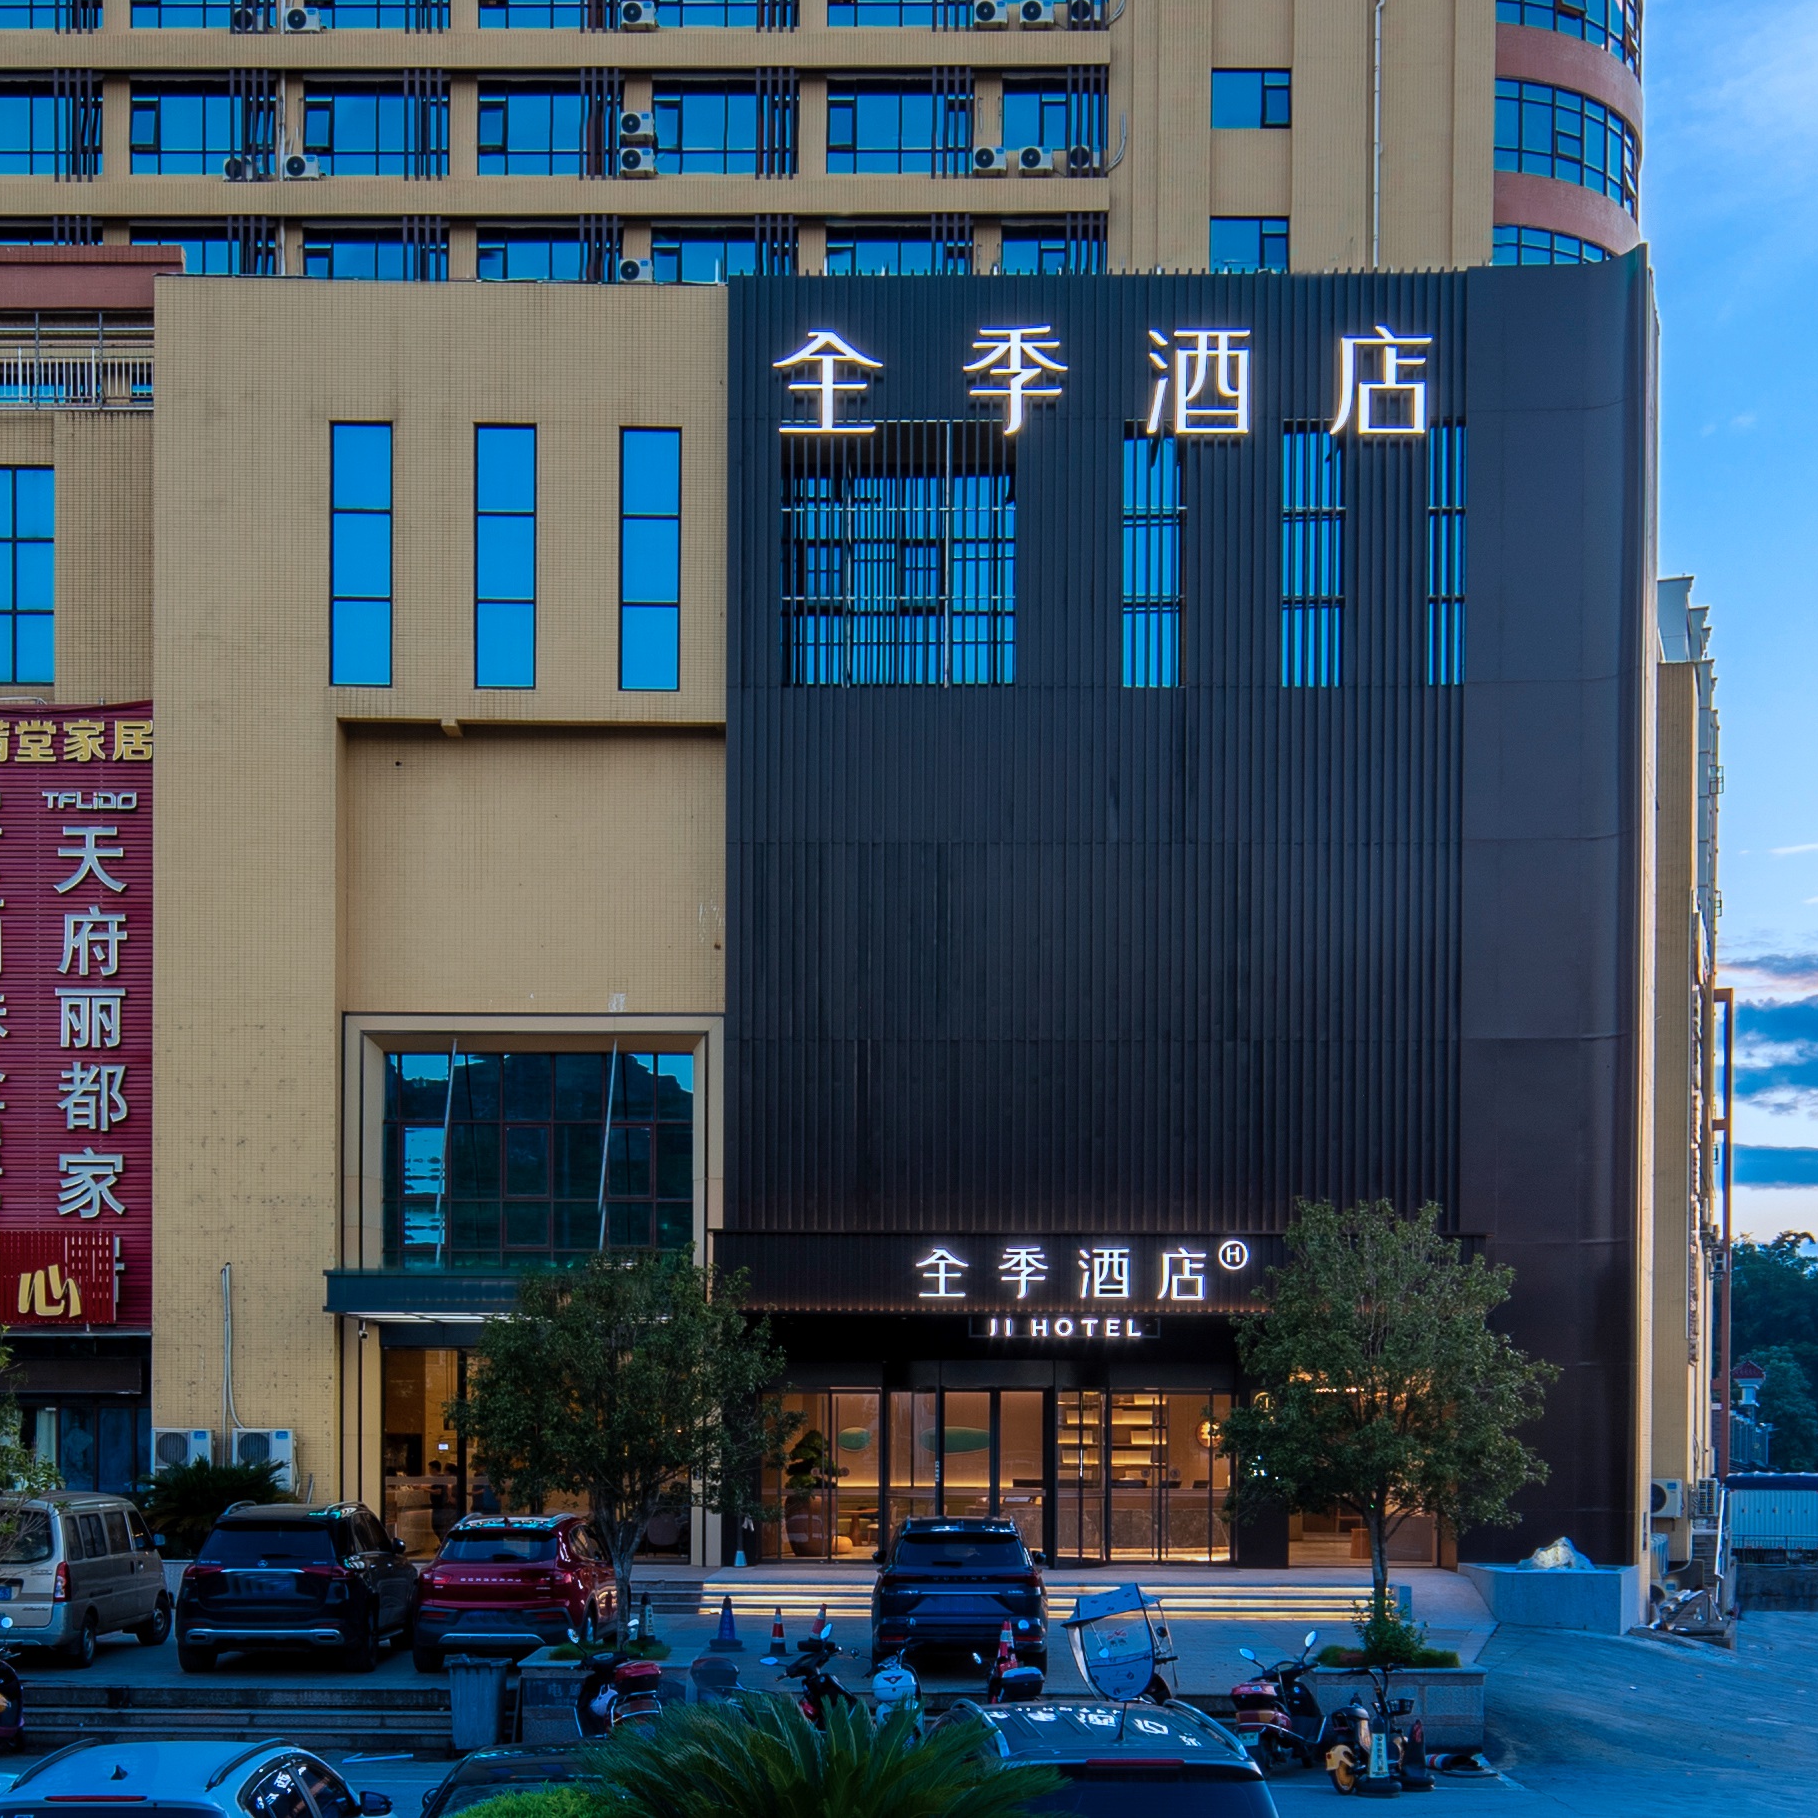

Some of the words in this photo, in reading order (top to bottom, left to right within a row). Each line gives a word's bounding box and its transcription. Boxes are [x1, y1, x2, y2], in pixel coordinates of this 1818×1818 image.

[772, 324, 1433, 435] 全季酒店
[53, 825, 128, 1303] 天府丽都家
[915, 1246, 1207, 1301] 全季酒店
[989, 1319, 1013, 1337] JI
[1030, 1319, 1142, 1337] HOTEL
